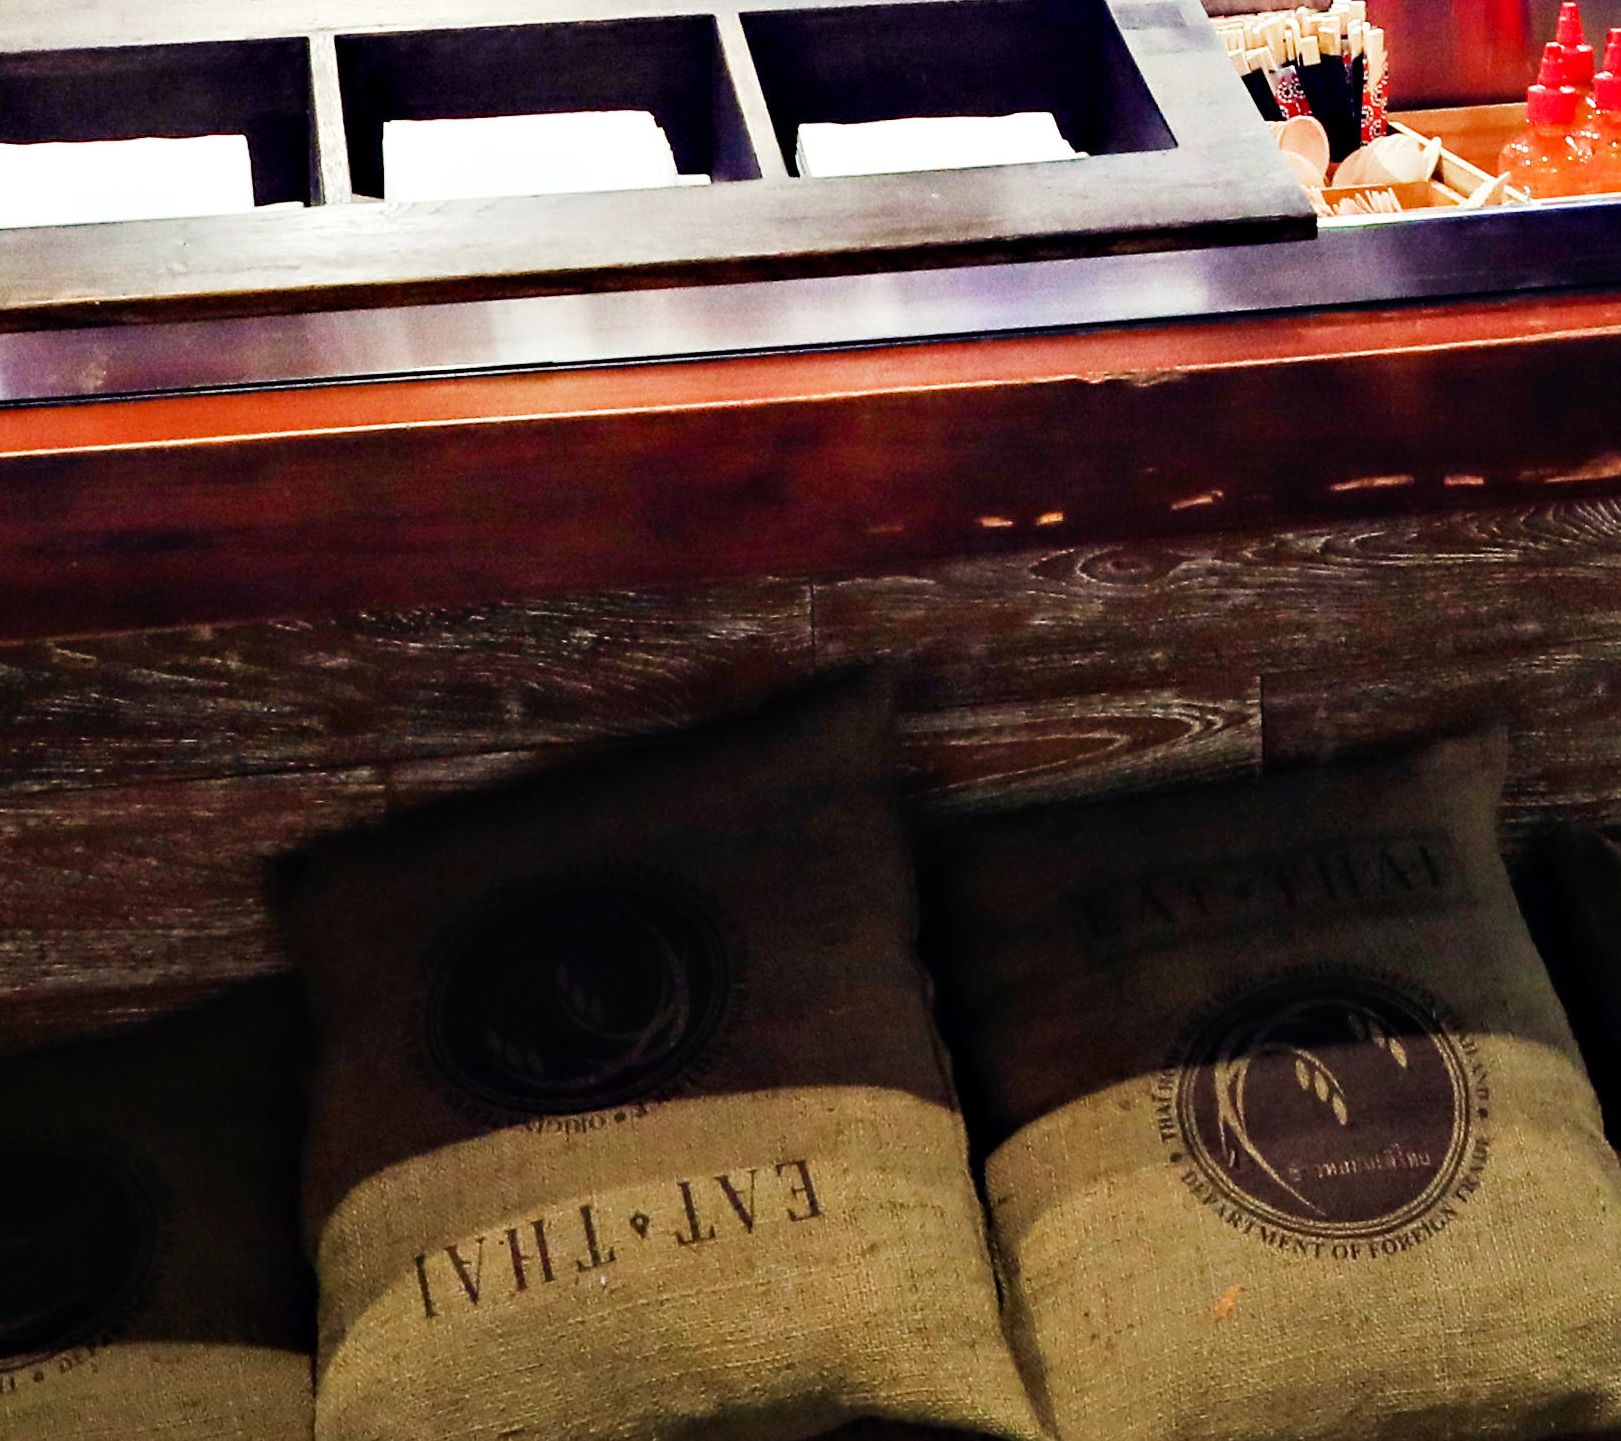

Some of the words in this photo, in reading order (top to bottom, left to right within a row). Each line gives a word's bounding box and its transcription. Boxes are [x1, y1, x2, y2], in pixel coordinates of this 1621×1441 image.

[676, 1158, 824, 1245] EAT
[1181, 1170, 1324, 1260] DEPARTMENT
[1331, 1243, 1363, 1262] OF
[1368, 1205, 1460, 1260] FOREIGN
[413, 1203, 616, 1318] THAI
